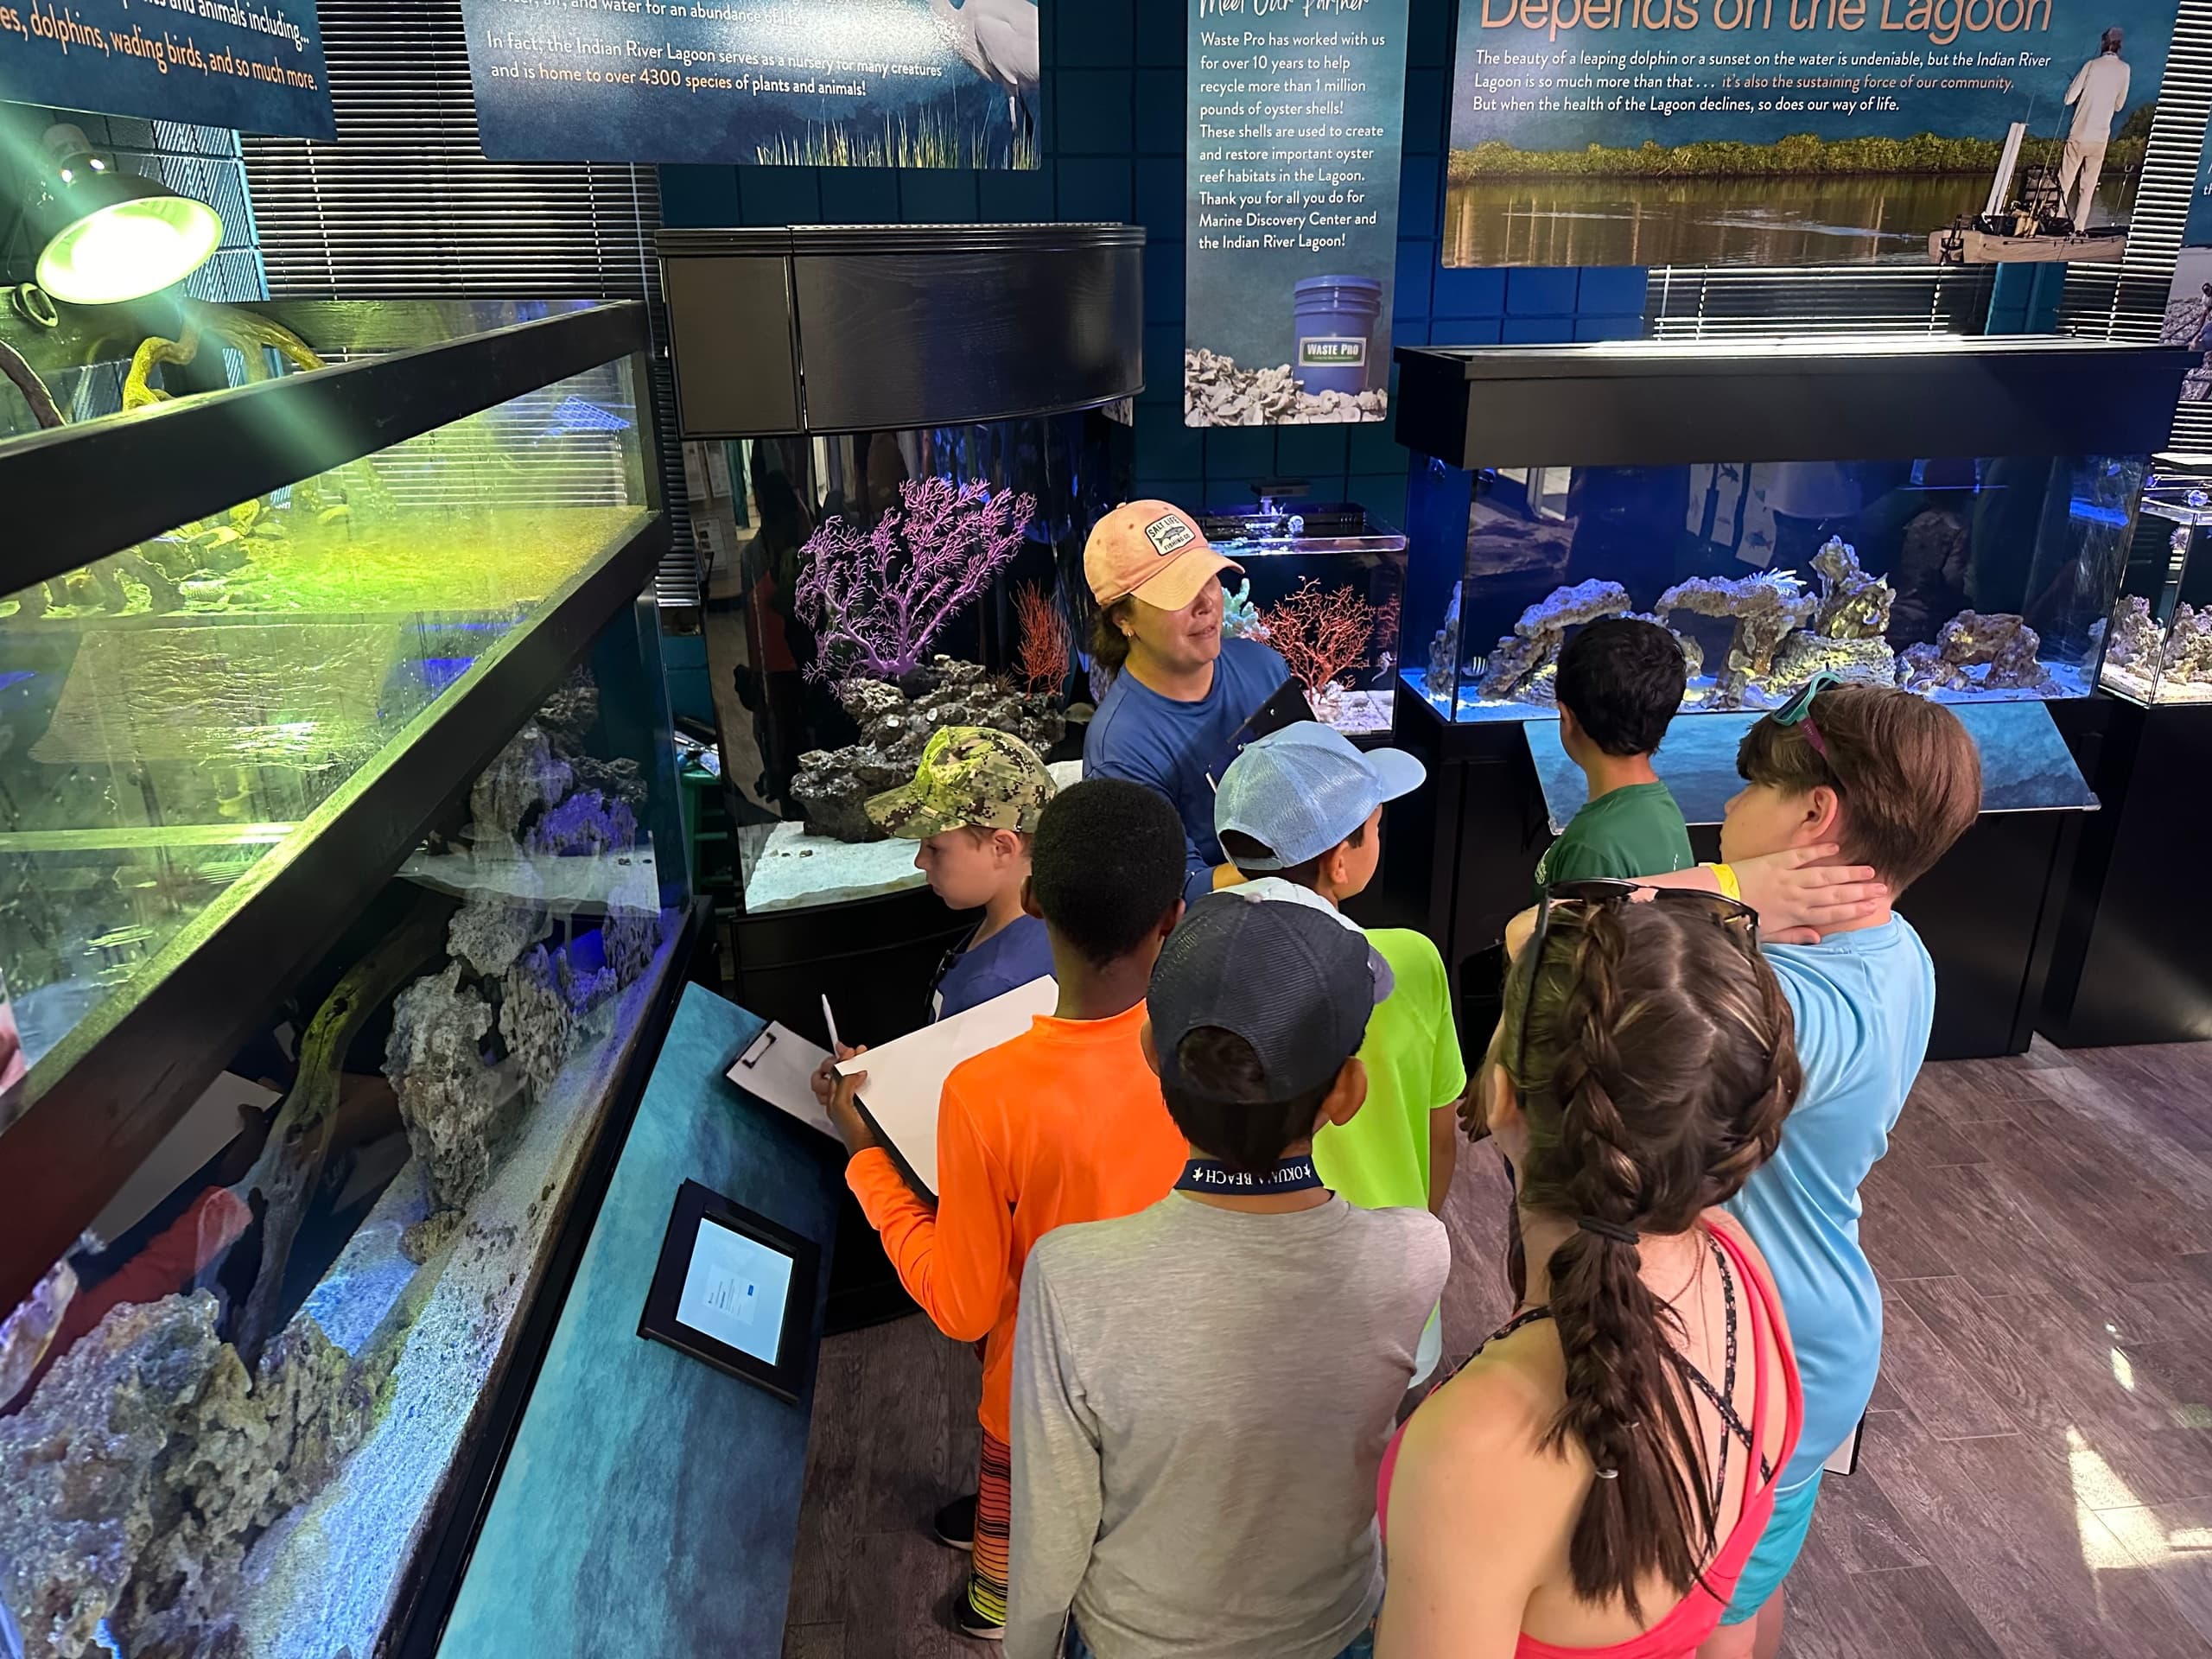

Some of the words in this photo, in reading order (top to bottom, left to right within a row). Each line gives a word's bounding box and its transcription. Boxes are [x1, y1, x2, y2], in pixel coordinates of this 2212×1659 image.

[602, 0, 642, 13] water
[645, 1, 665, 16] for
[670, 5, 687, 17] an
[690, 3, 761, 22] abundance
[764, 8, 779, 24] of
[1199, 0, 1245, 19] Meet
[1253, 0, 1288, 16] Our
[170, 0, 196, 15] and
[198, 0, 248, 28] animals
[246, 1, 310, 52] including...
[1480, 0, 1700, 42] Depends
[1713, 0, 1772, 30] on
[1788, 0, 1866, 31] the
[1879, 0, 2052, 45] Lagoon
[29, 0, 110, 58] dolphins,
[110, 23, 169, 74] wading
[164, 31, 208, 76] birds,
[208, 45, 234, 74] and
[235, 58, 250, 78] so
[251, 56, 285, 85] much
[286, 69, 318, 91] more.
[1200, 31, 1240, 47] Waste
[1243, 31, 1266, 47] Pro
[1268, 31, 1289, 46] has
[1292, 31, 1338, 46] worked
[1340, 31, 1368, 46] with
[1371, 36, 1385, 46] us
[486, 29, 504, 48] In
[506, 31, 544, 54] fact,
[546, 34, 574, 54] the
[576, 36, 622, 57] Indian
[626, 39, 664, 60] River
[667, 42, 715, 67] Lagoon
[718, 52, 760, 66] serves
[760, 55, 775, 67] as
[778, 56, 785, 67] a
[788, 57, 834, 75] nursery
[836, 60, 855, 72] for
[856, 61, 889, 79] many
[891, 63, 943, 77] creatures
[1200, 54, 1219, 70] for
[1222, 60, 1249, 70] over
[1252, 54, 1268, 69] 10
[1271, 60, 1304, 74] years
[1306, 57, 1321, 69] to
[1324, 54, 1351, 74] help
[1476, 48, 1501, 65] The
[1503, 49, 1549, 70] beauty
[1551, 49, 1568, 65] of
[1568, 54, 1576, 65] a
[1580, 49, 1627, 71] leaping
[1629, 49, 1678, 71] dolphin
[1681, 55, 1696, 66] or
[1698, 55, 1706, 66] a
[1708, 54, 1751, 66] sunset
[1753, 55, 1770, 66] on
[1774, 50, 1796, 66] the
[1799, 54, 1835, 66] water
[1837, 55, 1847, 66] is
[1851, 50, 1923, 69] undeniable,
[1927, 51, 1949, 67] but
[1952, 51, 1974, 67] the
[1976, 51, 2015, 67] Indian
[2018, 51, 2051, 67] River
[491, 60, 520, 79] and
[523, 67, 536, 79] is
[538, 62, 582, 82] home
[585, 68, 602, 83] to
[605, 72, 637, 84] over
[639, 67, 681, 86] 4300
[684, 73, 733, 93] species
[735, 73, 750, 90] of
[752, 74, 791, 97] plants
[792, 77, 816, 94] and
[817, 79, 867, 97] animals!
[1200, 78, 1245, 98] recycle
[1248, 83, 1281, 92] more
[1283, 78, 1312, 92] than
[1315, 78, 1320, 92] 1
[1324, 78, 1366, 92] million
[1474, 72, 1522, 93] Lagoon
[1525, 73, 1535, 88] is
[1538, 78, 1553, 88] so
[1556, 73, 1592, 88] much
[1596, 78, 1630, 88] more
[1633, 73, 1663, 88] than
[1721, 73, 1741, 88] it's
[1744, 73, 1769, 88] also
[1772, 73, 1794, 88] the
[1796, 76, 1860, 94] sustaining
[1863, 73, 1897, 89] force
[1899, 73, 1916, 88] of
[1916, 79, 1938, 89] our
[1940, 77, 2014, 94] community.
[1199, 100, 1245, 121] pounds
[1248, 100, 1262, 115] of
[1263, 104, 1303, 120] oyster
[1306, 100, 1344, 115] shells!
[1472, 95, 1497, 111] But
[1500, 96, 1535, 111] when
[1538, 95, 1560, 111] the
[1563, 95, 1605, 111] health
[1607, 95, 1624, 111] of
[1624, 96, 1647, 111] the
[1649, 95, 1696, 117] Lagoon
[1699, 95, 1754, 114] declines,
[1758, 101, 1772, 111] so
[1775, 95, 1804, 111] does
[1807, 101, 1830, 111] our
[1832, 101, 1858, 117] way
[1859, 95, 1875, 111] of
[1876, 96, 1899, 111] life.
[1198, 124, 1236, 138] These
[1238, 124, 1273, 138] shells
[1274, 128, 1295, 138] are
[1298, 123, 1326, 137] used
[1329, 126, 1343, 137] to
[1344, 125, 1384, 137] create
[1199, 147, 1222, 161] and
[1225, 149, 1268, 161] restore
[1272, 148, 1333, 165] important
[1335, 148, 1375, 164] oyster
[1199, 168, 1225, 183] reef
[1227, 168, 1276, 183] habitats
[1279, 173, 1291, 182] in
[1294, 168, 1315, 182] the
[1318, 168, 1365, 187] Lagoon.
[1198, 190, 1237, 206] Thank
[1239, 195, 1262, 210] you
[1265, 190, 1284, 205] for
[1286, 190, 1300, 204] all
[1303, 194, 1325, 209] you
[1328, 189, 1344, 204] do
[1346, 189, 1365, 203] for
[1198, 213, 1243, 227] Marine
[1246, 212, 1306, 231] Discovery
[1308, 211, 1352, 226] Center
[1354, 210, 1376, 225] and
[1198, 235, 1219, 250] the
[1223, 234, 1260, 249] Indian
[1263, 233, 1295, 248] River
[1298, 232, 1345, 252] Lagoon!
[1307, 343, 1338, 355] WASTE
[1341, 343, 1359, 355] PRO
[1148, 521, 1165, 537] SALT
[1164, 516, 1179, 525] LIFE
[1206, 1169, 1252, 1185] BEACH
